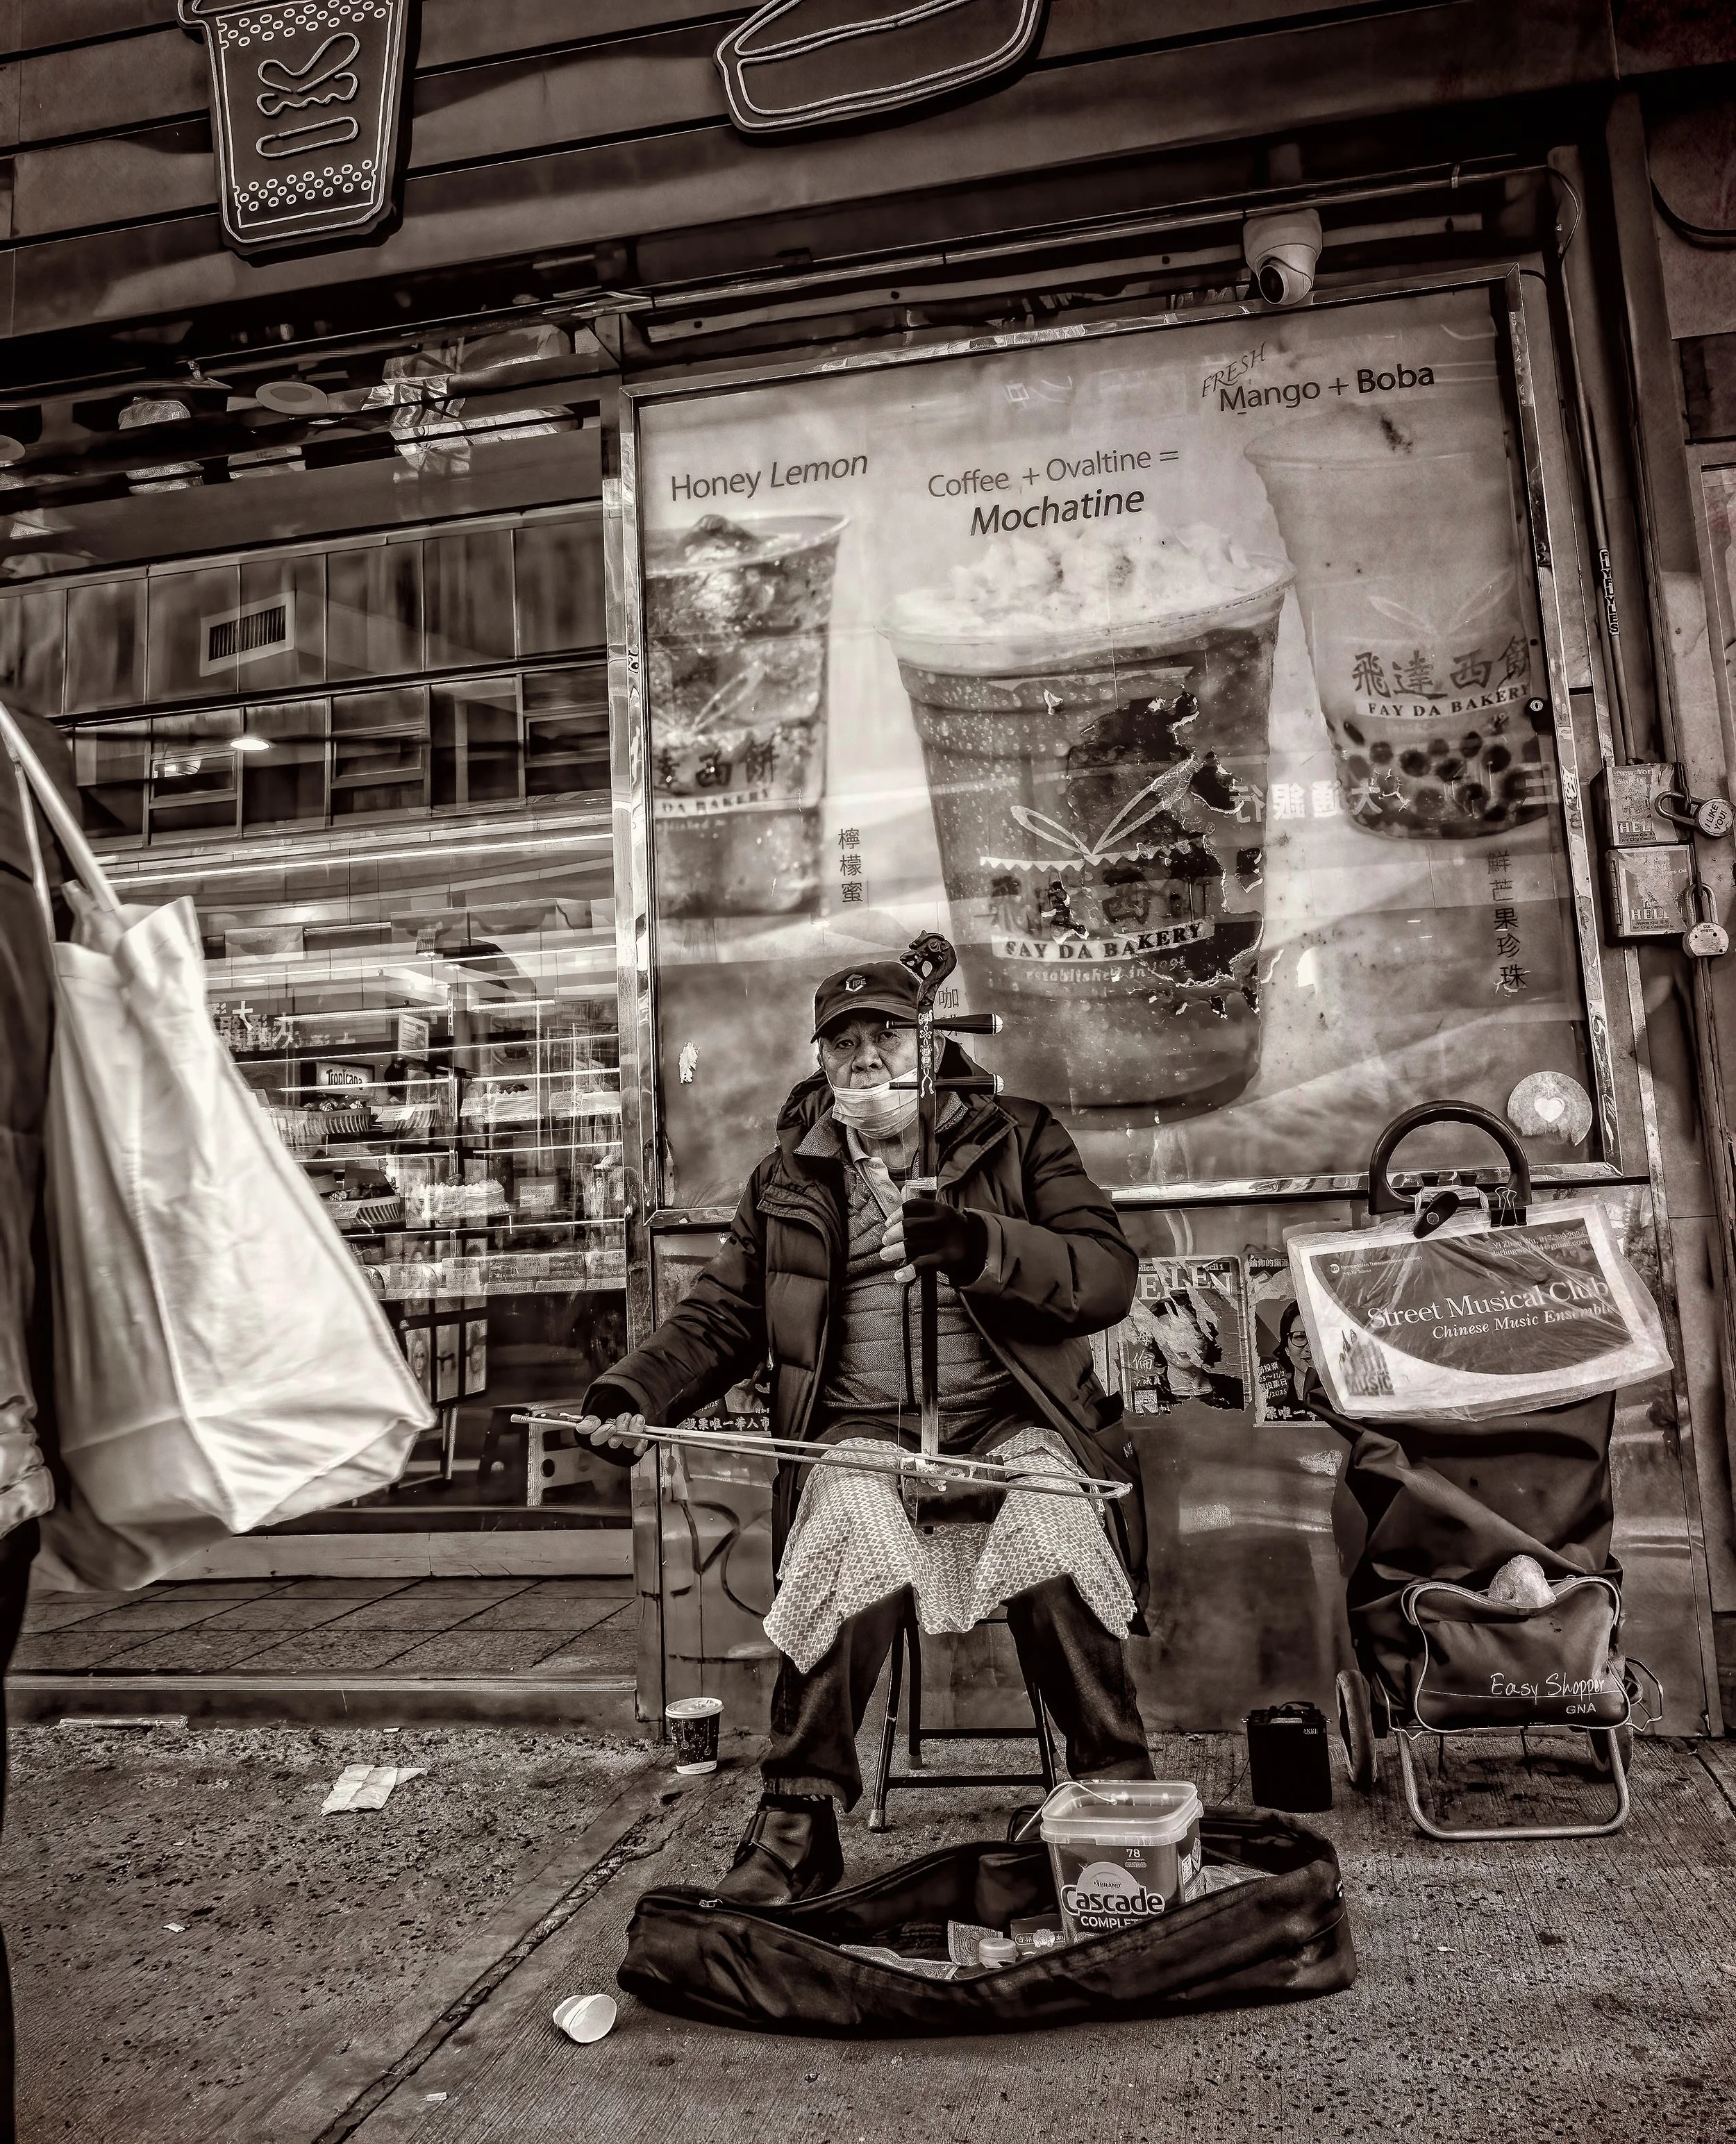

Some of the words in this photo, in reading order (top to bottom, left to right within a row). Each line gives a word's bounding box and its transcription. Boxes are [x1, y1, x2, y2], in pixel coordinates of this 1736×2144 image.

[1202, 340, 1266, 398] FRESH
[1220, 381, 1320, 412] Mango
[1328, 377, 1349, 396] +
[1357, 363, 1435, 393] Boba
[671, 471, 762, 501] Honey
[771, 454, 868, 488] Lemon
[928, 469, 1010, 497] Coffee
[1022, 467, 1040, 485] +
[1046, 449, 1151, 481] Ovaltine
[970, 488, 1145, 536] Mochatine
[1369, 703, 1403, 717] FAY
[1414, 705, 1442, 717] DA
[1618, 822, 1652, 833] HEL
[1708, 803, 1719, 822] LIKE
[1713, 810, 1728, 831] YOU!
[838, 828, 864, 903] 檸檬蜜
[1487, 850, 1526, 987] 鮮芒果珍珠
[1006, 941, 1047, 958] FAY
[1059, 944, 1092, 959] DA
[1104, 922, 1203, 957] BAKERY
[1367, 1300, 1443, 1330] Street
[1444, 1285, 1544, 1318] Musical
[1549, 1277, 1609, 1303] Club
[1433, 1322, 1489, 1339] Chinese
[1494, 1314, 1539, 1332] Music
[1490, 1673, 1538, 1705] Easy
[1545, 1673, 1605, 1700] Shopper
[1126, 1848, 1141, 1858] 78
[1061, 1884, 1165, 1916] Cascade
